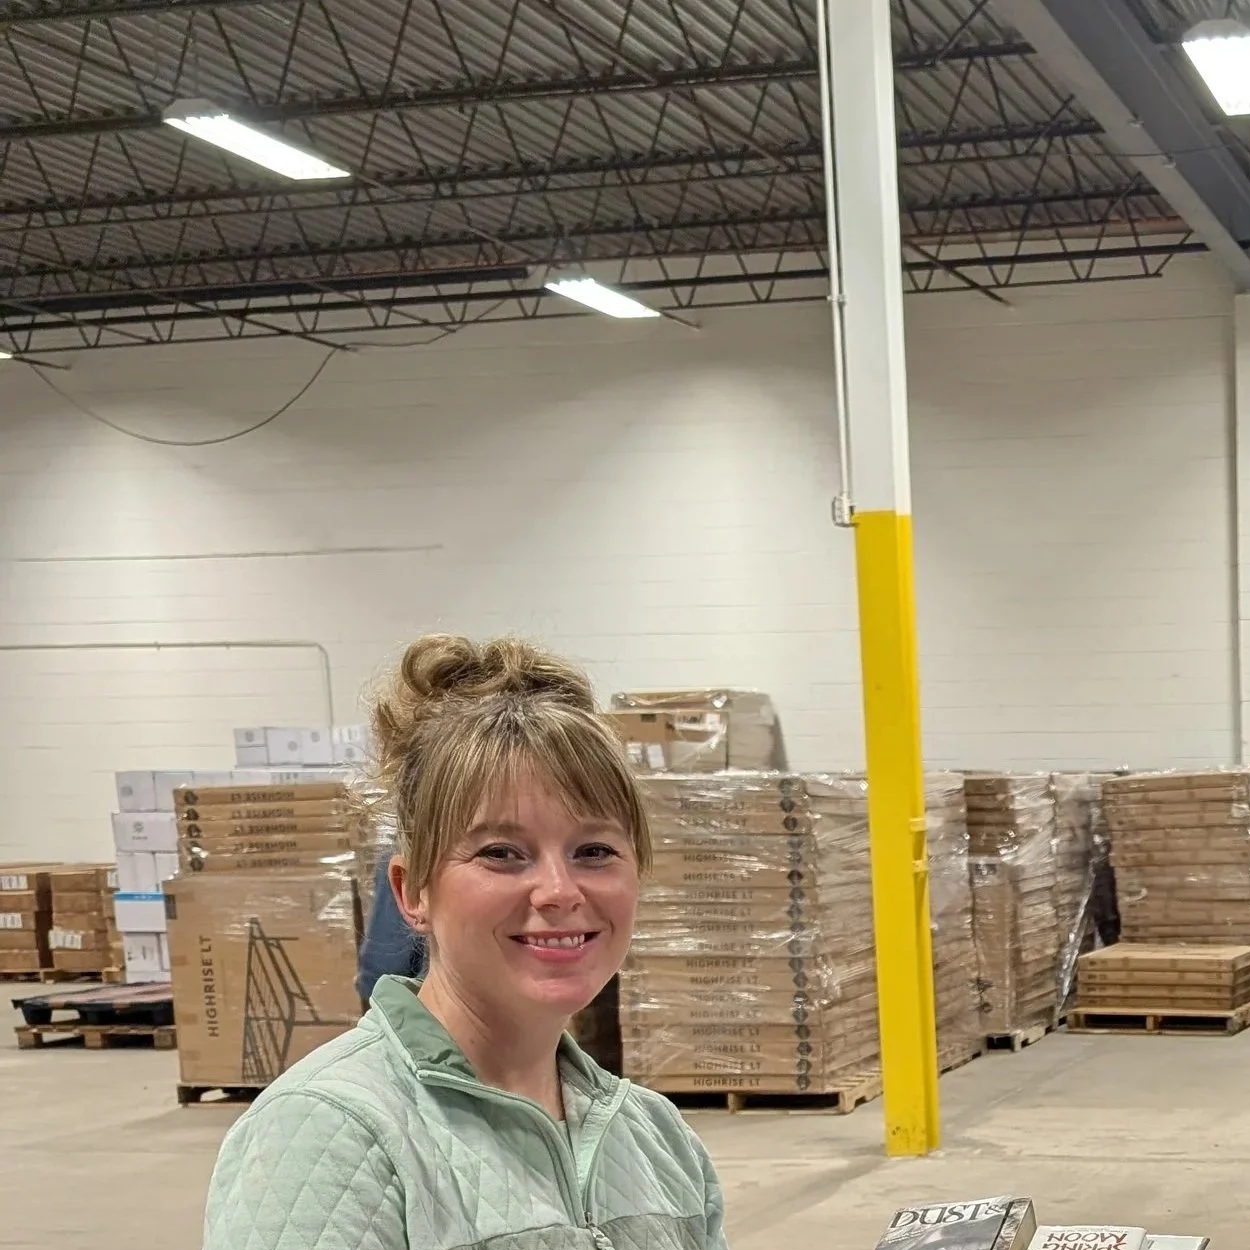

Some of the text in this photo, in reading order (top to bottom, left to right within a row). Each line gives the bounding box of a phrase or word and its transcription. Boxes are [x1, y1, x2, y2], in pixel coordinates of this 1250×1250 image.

[199, 935, 219, 1037] HIGHRISE LT
[694, 1078, 760, 1086] HIGHRISE LT
[890, 1202, 989, 1229] DUST
[1047, 1232, 1128, 1242] MOON
